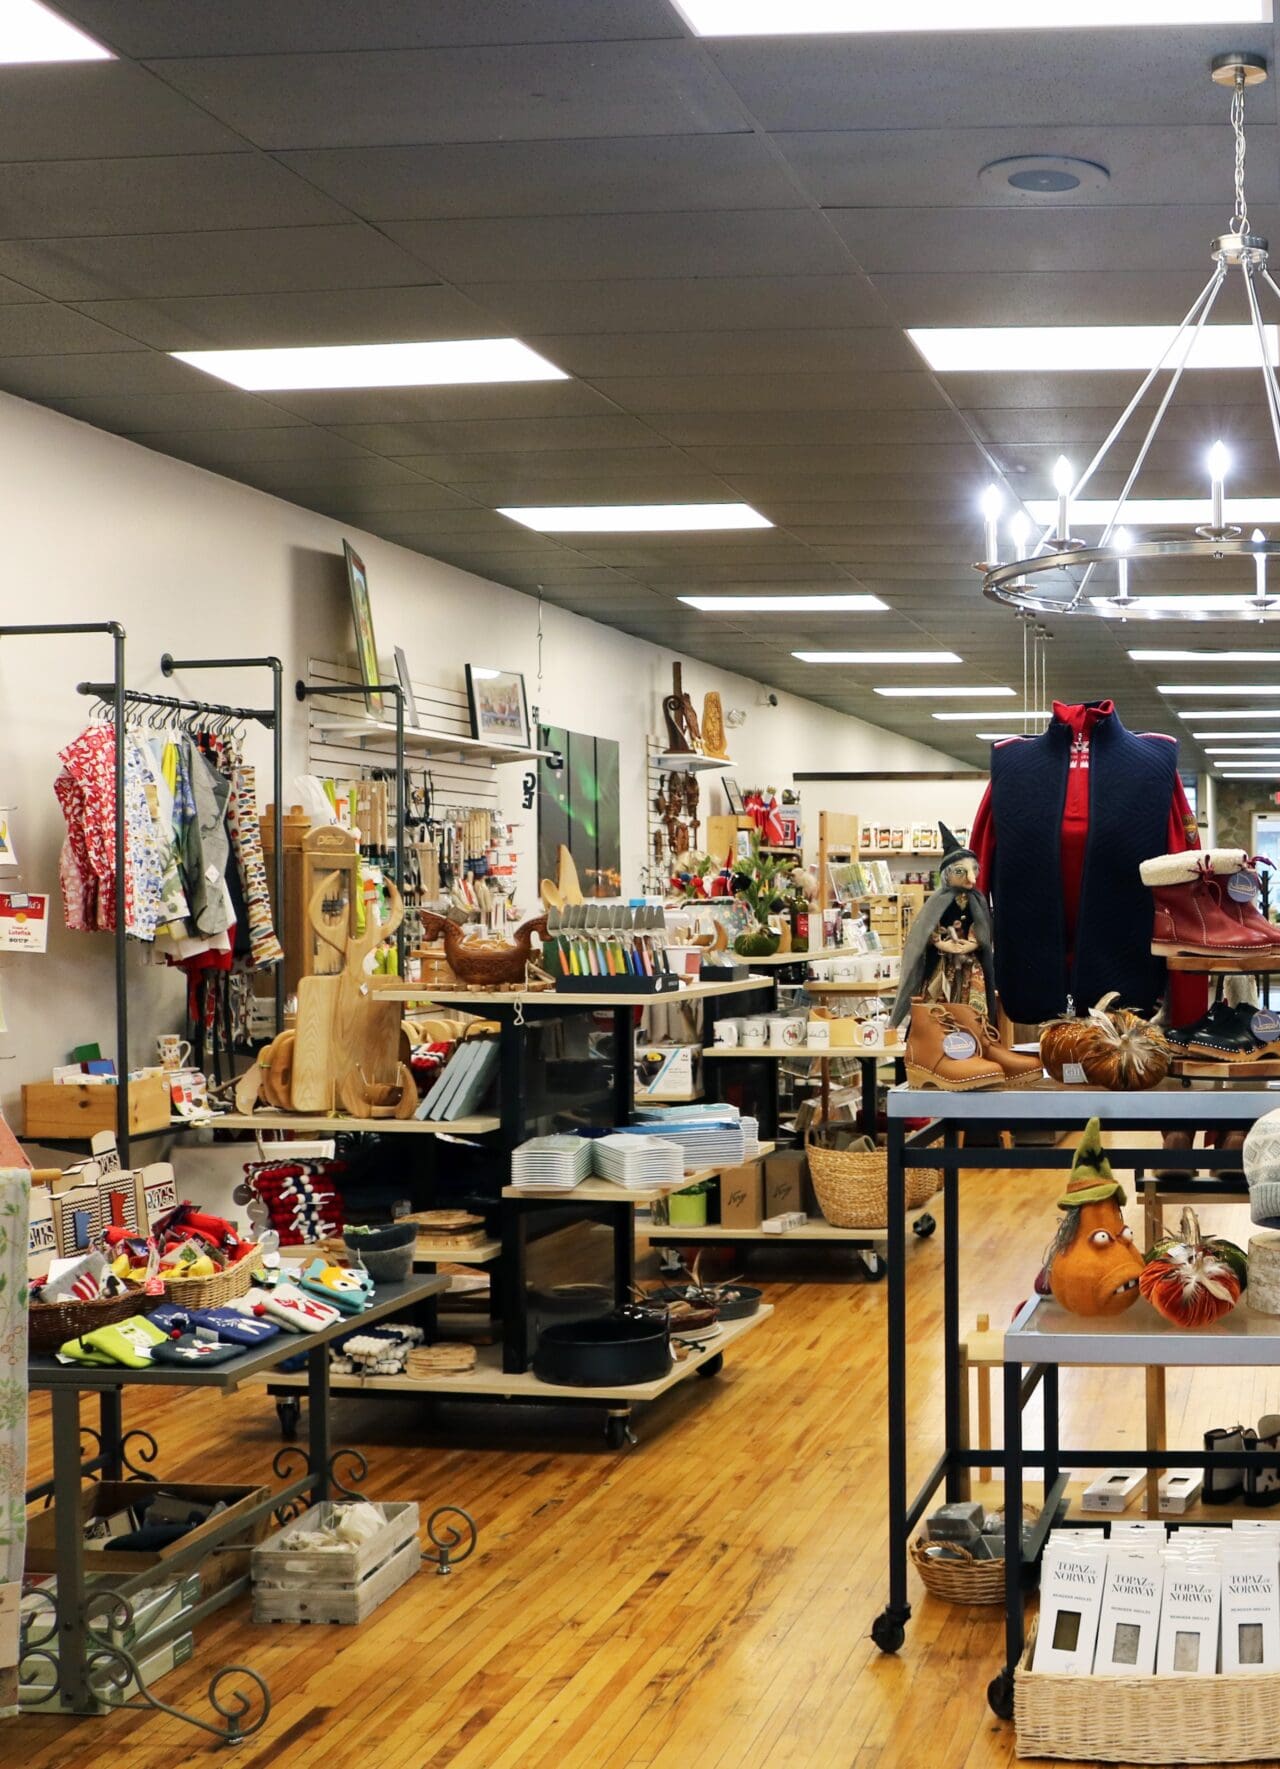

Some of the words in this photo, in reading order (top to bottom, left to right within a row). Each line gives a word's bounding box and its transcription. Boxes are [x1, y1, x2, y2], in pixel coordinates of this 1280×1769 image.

[1057, 1561, 1090, 1573] TOPAZ
[1053, 1571, 1098, 1584] NORWAY
[1115, 1574, 1148, 1586] TOPAZ
[1230, 1575, 1264, 1584] TOPAZ
[1112, 1584, 1156, 1597] NORWAY
[1173, 1583, 1206, 1593] TOPAZ
[1229, 1584, 1272, 1594] NORWAY
[1169, 1592, 1213, 1603] NORWAY
